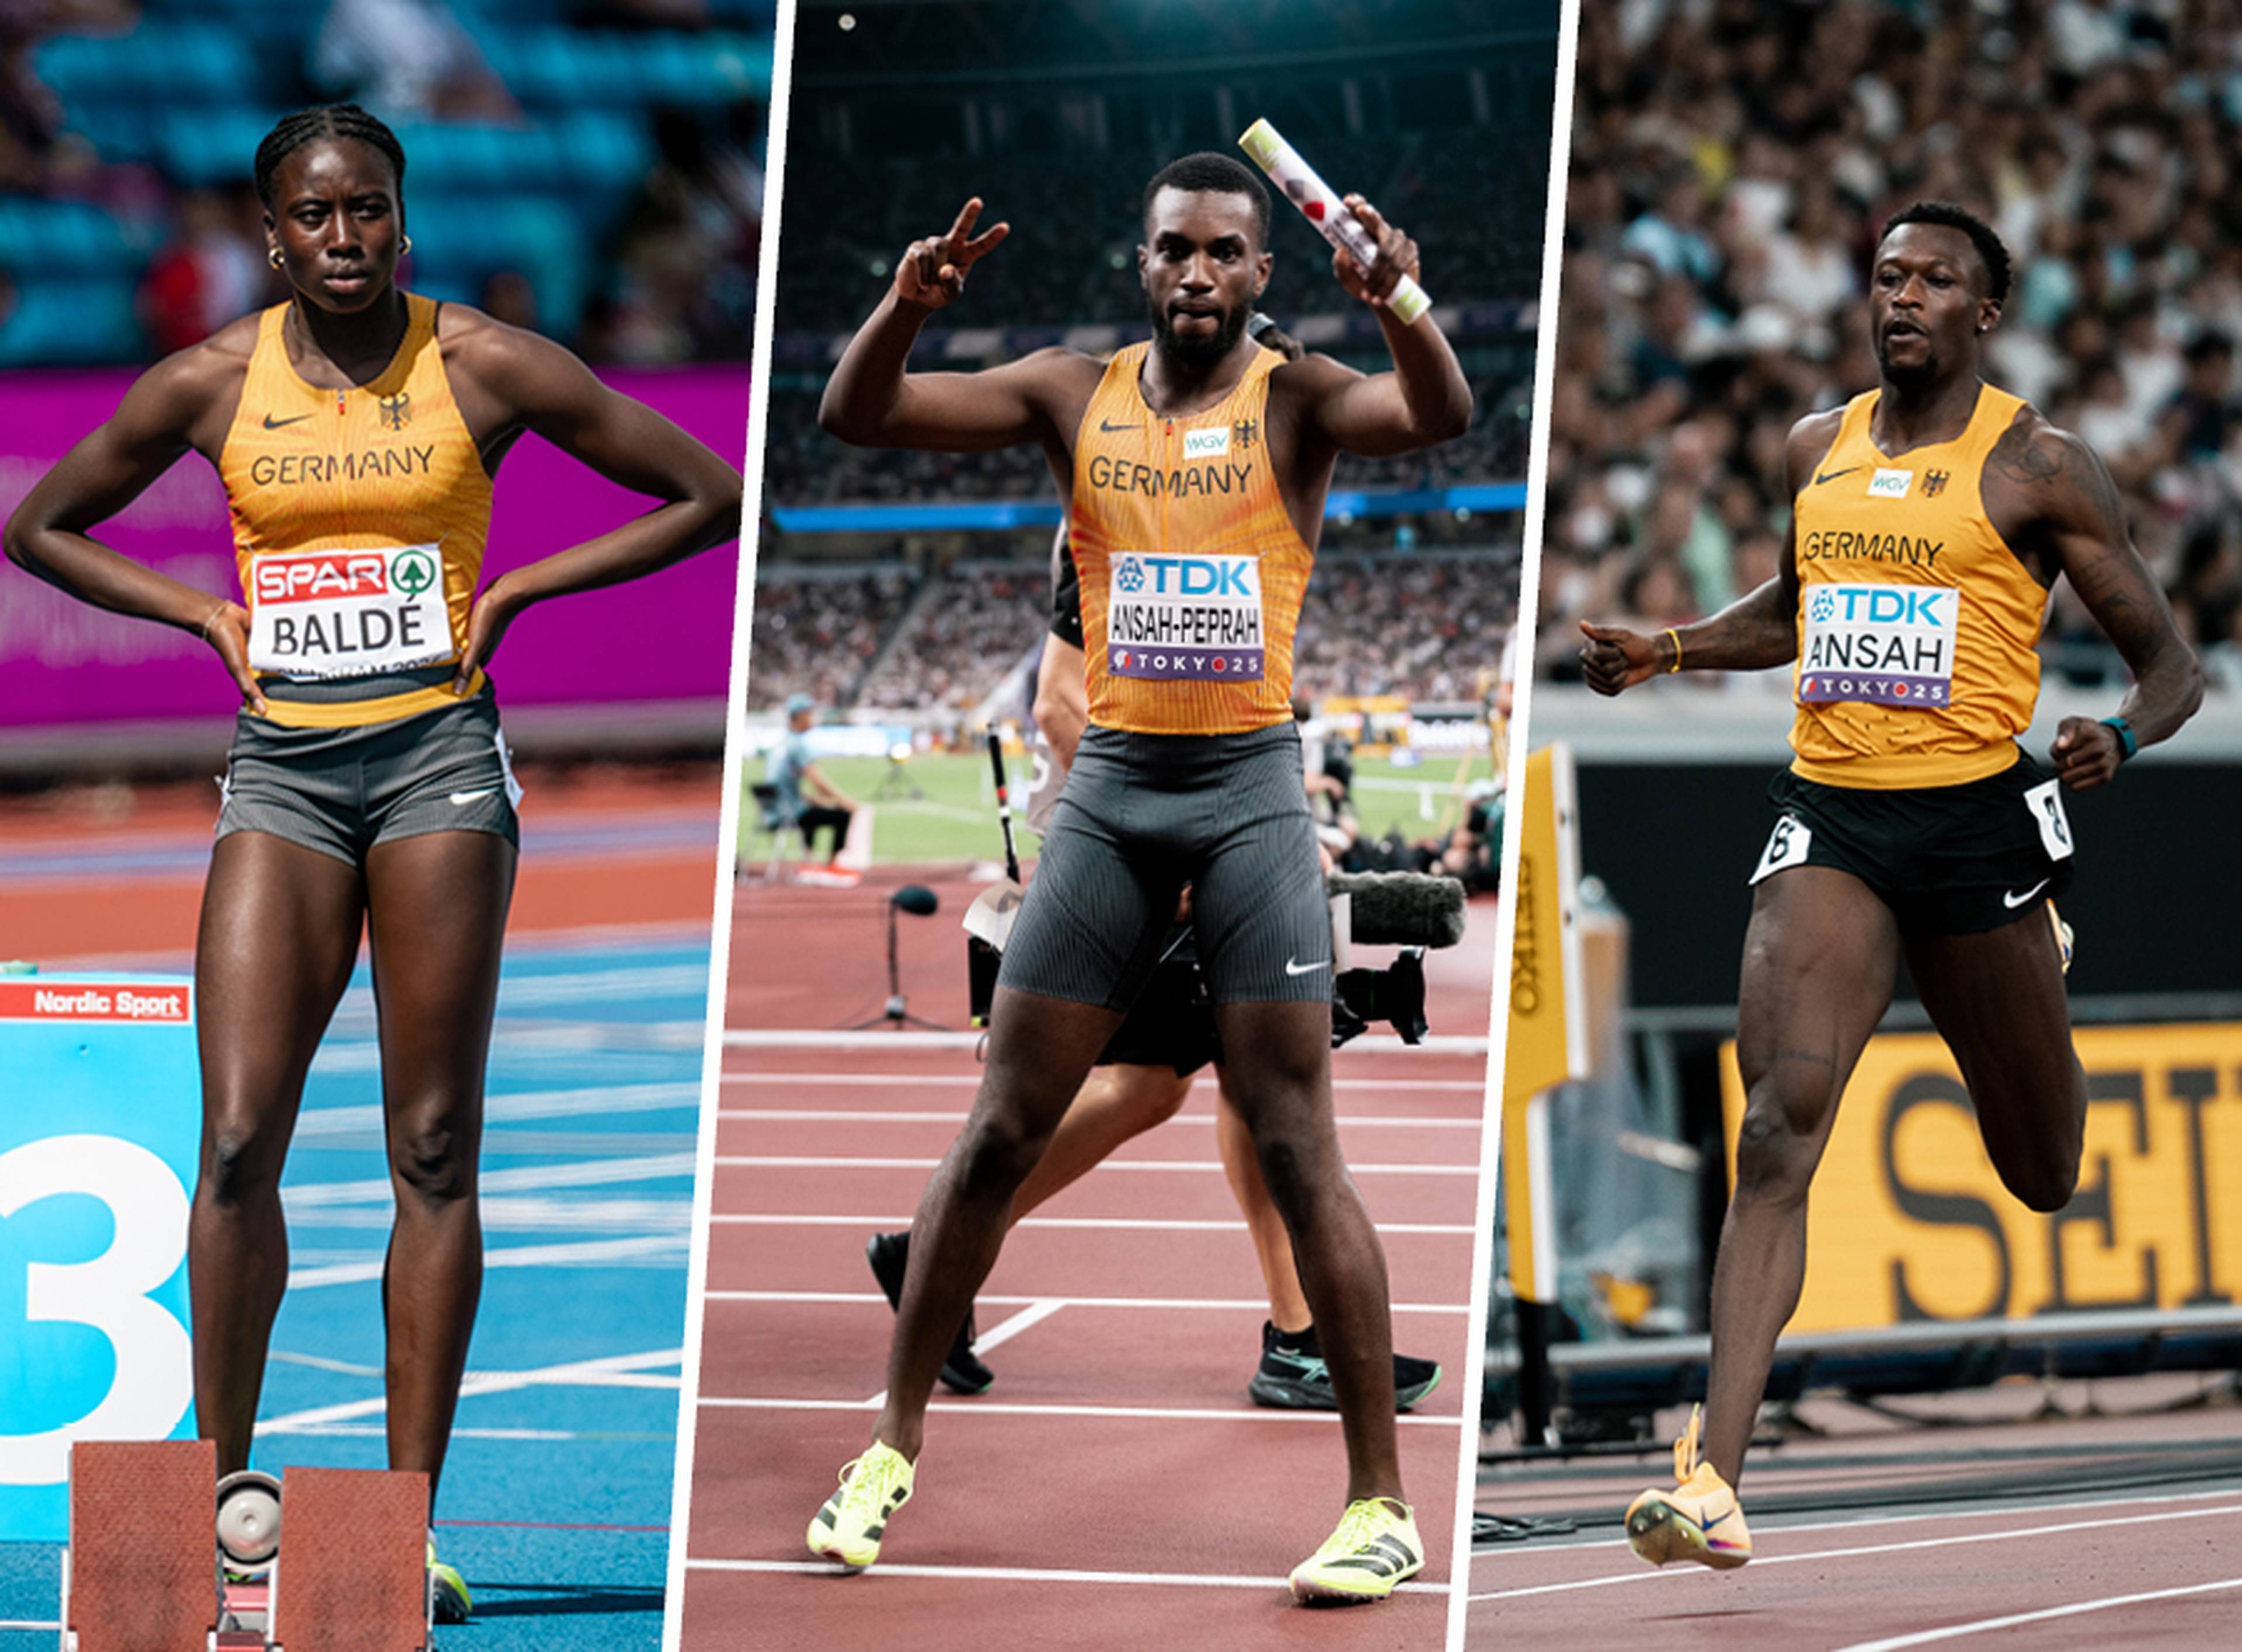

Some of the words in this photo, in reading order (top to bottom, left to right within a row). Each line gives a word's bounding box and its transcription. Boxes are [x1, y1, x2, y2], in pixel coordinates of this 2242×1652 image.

[1186, 434, 1227, 450] WGV
[252, 445, 434, 486] GERMANY
[1089, 455, 1252, 498] GERMANY
[1805, 532, 1944, 567] GERMANY
[259, 558, 384, 600] SPAR
[1144, 558, 1251, 597] TDK
[271, 594, 425, 657] BALDÉ
[1112, 604, 1259, 644] ANSAH-PEPRAH
[1837, 588, 1942, 627] TDK
[1805, 633, 1943, 672] ANSAH
[34, 990, 111, 1012] Nordic
[116, 991, 182, 1017] Sport
[1881, 1067, 2242, 1324] SEI
[0, 1133, 194, 1484] 3
